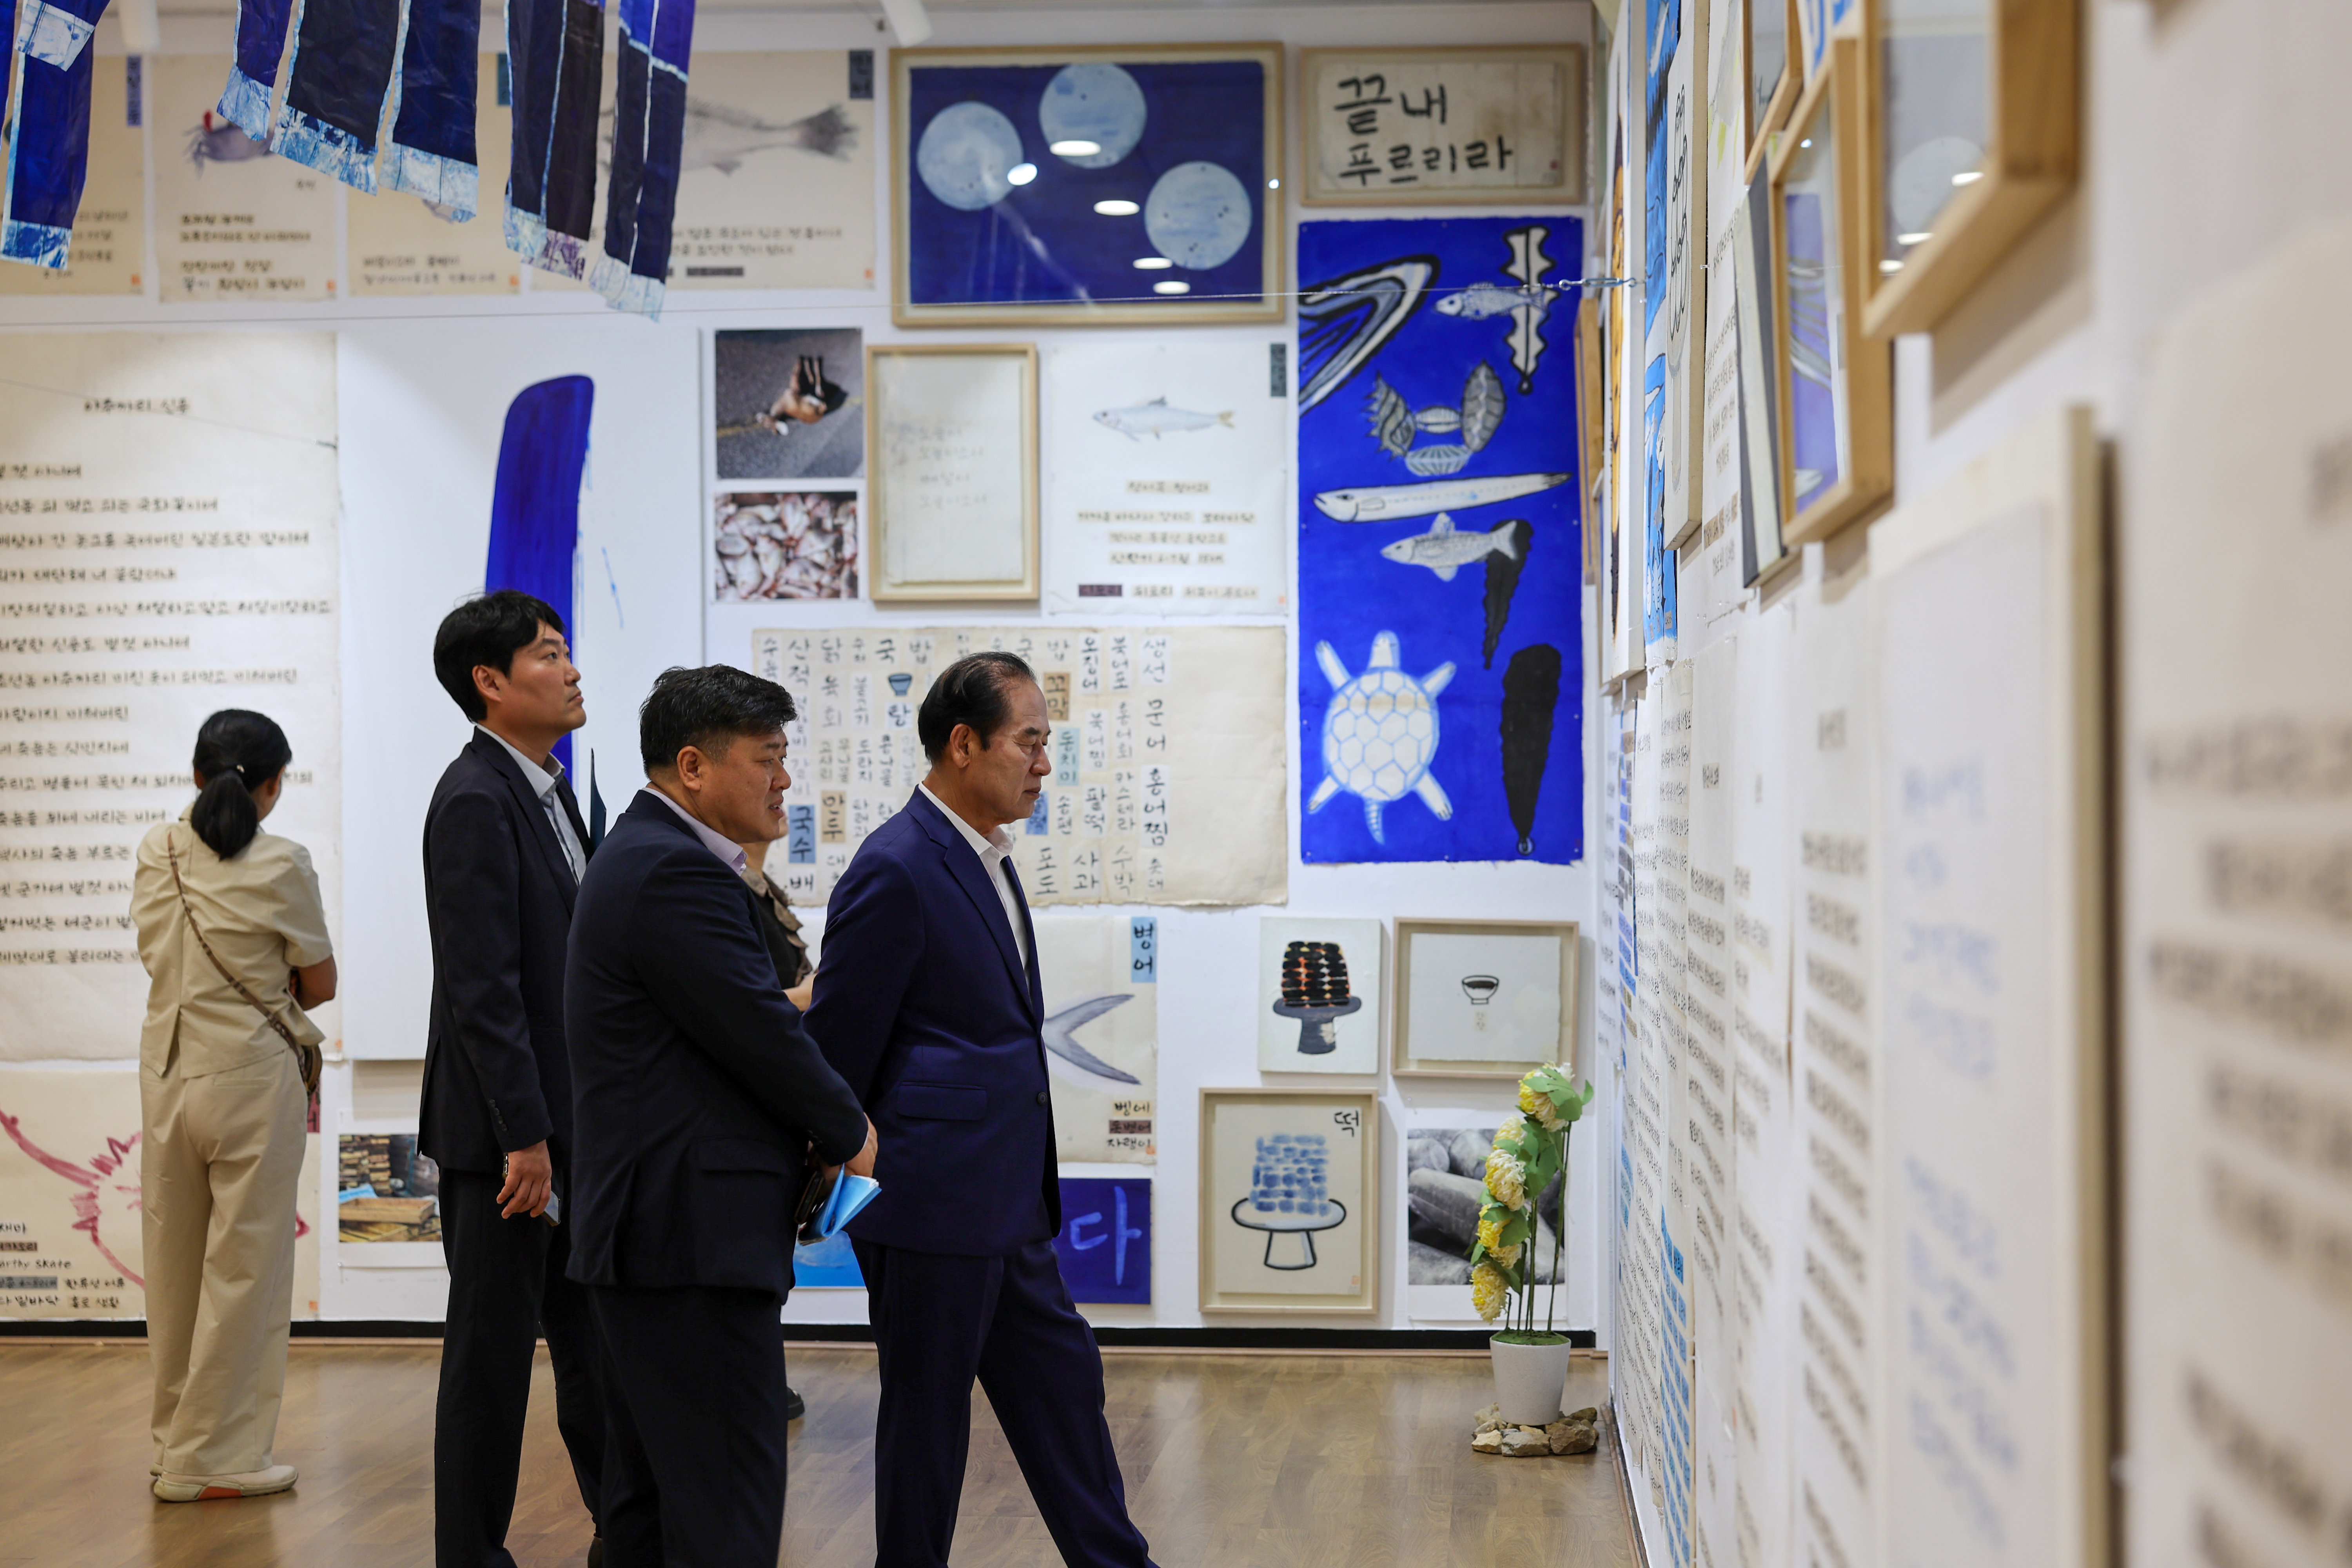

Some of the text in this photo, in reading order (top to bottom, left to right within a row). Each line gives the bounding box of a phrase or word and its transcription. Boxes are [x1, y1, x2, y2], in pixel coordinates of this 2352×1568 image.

[1334, 73, 1448, 135] 끝내
[1339, 135, 1513, 186] 푸르리라
[84, 397, 151, 413] 아주까리
[788, 637, 811, 687] 산적
[820, 637, 844, 664] 닭
[875, 638, 896, 664] 국
[909, 640, 932, 664] 밥
[1017, 638, 1033, 662] 국
[1047, 639, 1071, 661] 밥
[1081, 636, 1099, 690] 오징어
[1112, 635, 1129, 690] 북어포
[1143, 639, 1167, 683] 생선
[42, 671, 106, 687] 아주까리
[821, 674, 844, 728] 육회
[1046, 675, 1069, 719] 꼬막
[853, 676, 870, 727] 불고기
[887, 704, 911, 728] 탕
[1087, 710, 1106, 768] 북어찜
[1115, 701, 1133, 760] 홍어회
[1145, 699, 1166, 752] 문어
[789, 757, 811, 797] 갈비
[857, 739, 874, 782] 도라지
[878, 734, 894, 788] 콩나물
[1058, 730, 1076, 782] 동치미
[84, 810, 128, 825] 내리는
[822, 794, 846, 841] 만두
[1056, 795, 1072, 835] 송편
[1143, 768, 1169, 846] 홍어찜
[50, 845, 78, 861] 죽음
[87, 845, 130, 859] 부르는
[790, 806, 814, 863] 국수
[789, 874, 814, 891] 배
[1034, 846, 1059, 895] 포도
[1073, 851, 1100, 890] 사과
[1111, 844, 1136, 896] 수박
[1132, 922, 1156, 975] 병어
[1335, 1110, 1358, 1137] 떡
[15, 1295, 60, 1308] 밑바닥
